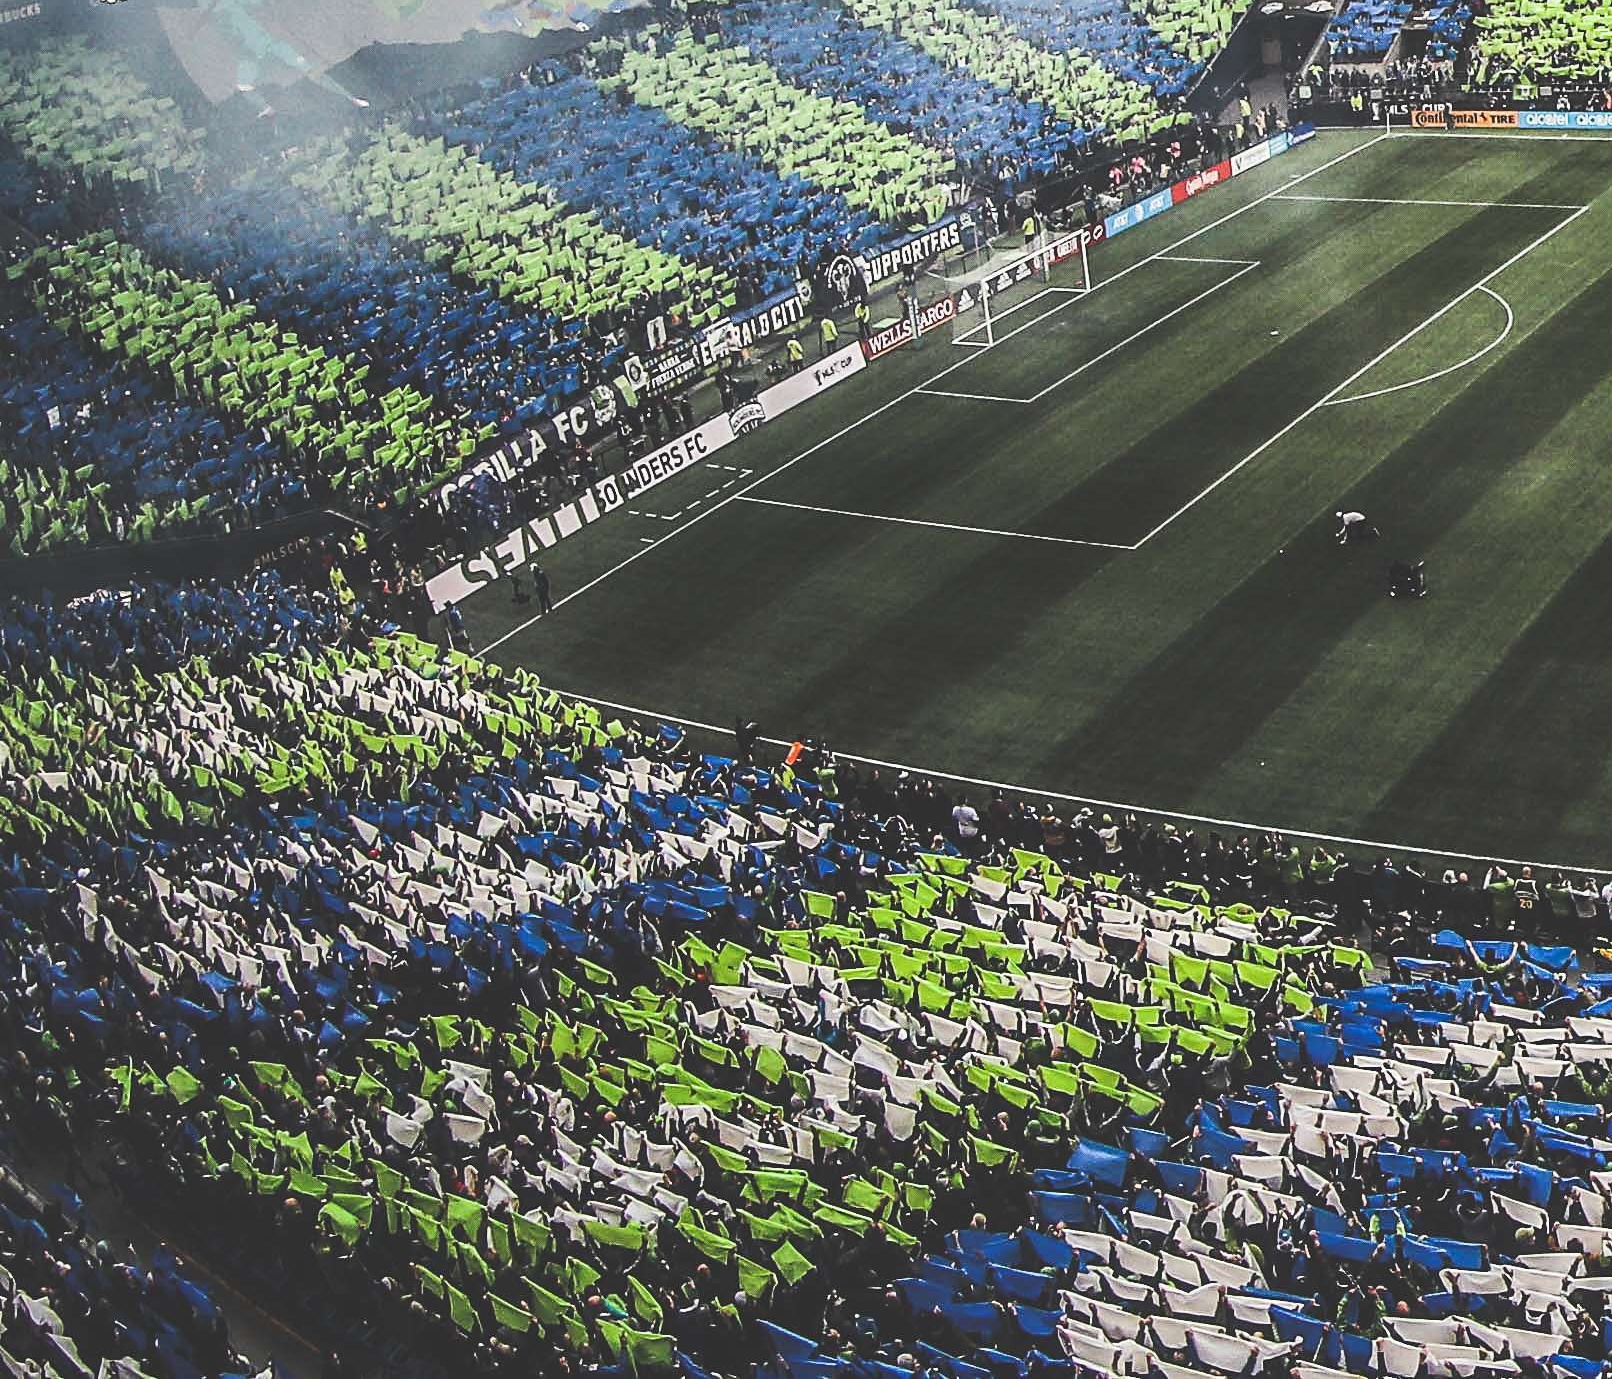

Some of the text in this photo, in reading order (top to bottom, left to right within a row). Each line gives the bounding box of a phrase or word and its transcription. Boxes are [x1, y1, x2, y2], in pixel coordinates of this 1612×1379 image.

[1491, 115, 1517, 125] TIRE
[863, 222, 961, 287] SUPPORTERS
[772, 297, 804, 329] CITY
[868, 320, 912, 354] WELLS
[552, 405, 589, 443] FC
[685, 432, 708, 462] FC
